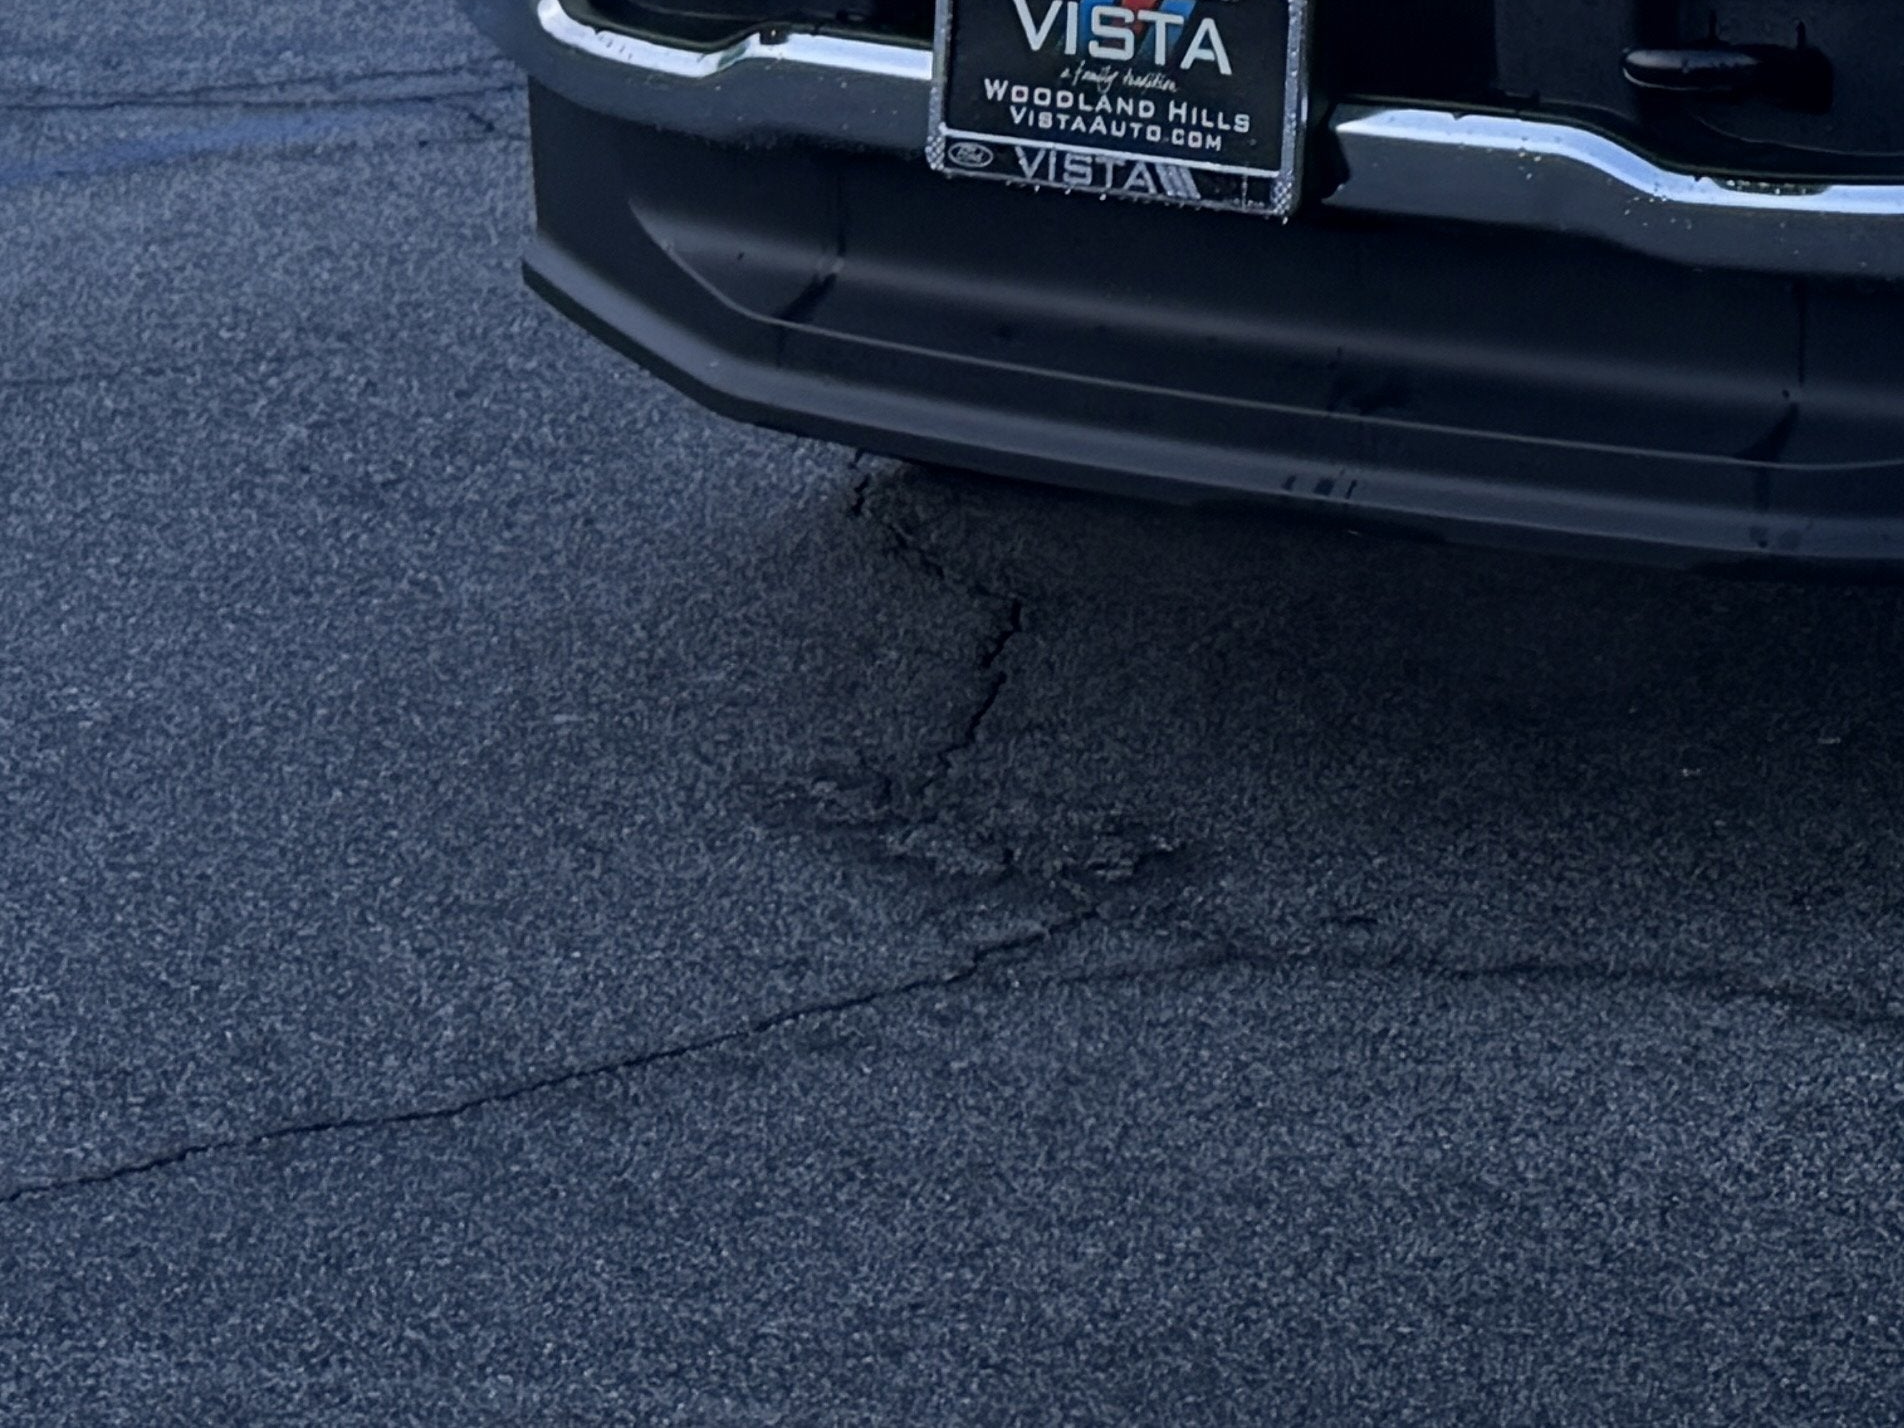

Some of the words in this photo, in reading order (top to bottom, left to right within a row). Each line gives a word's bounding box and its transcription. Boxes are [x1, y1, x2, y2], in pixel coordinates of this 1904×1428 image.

[984, 78, 1156, 119] WOODLAND
[1168, 99, 1251, 133] HILLS
[1014, 145, 1158, 195] VISTA
